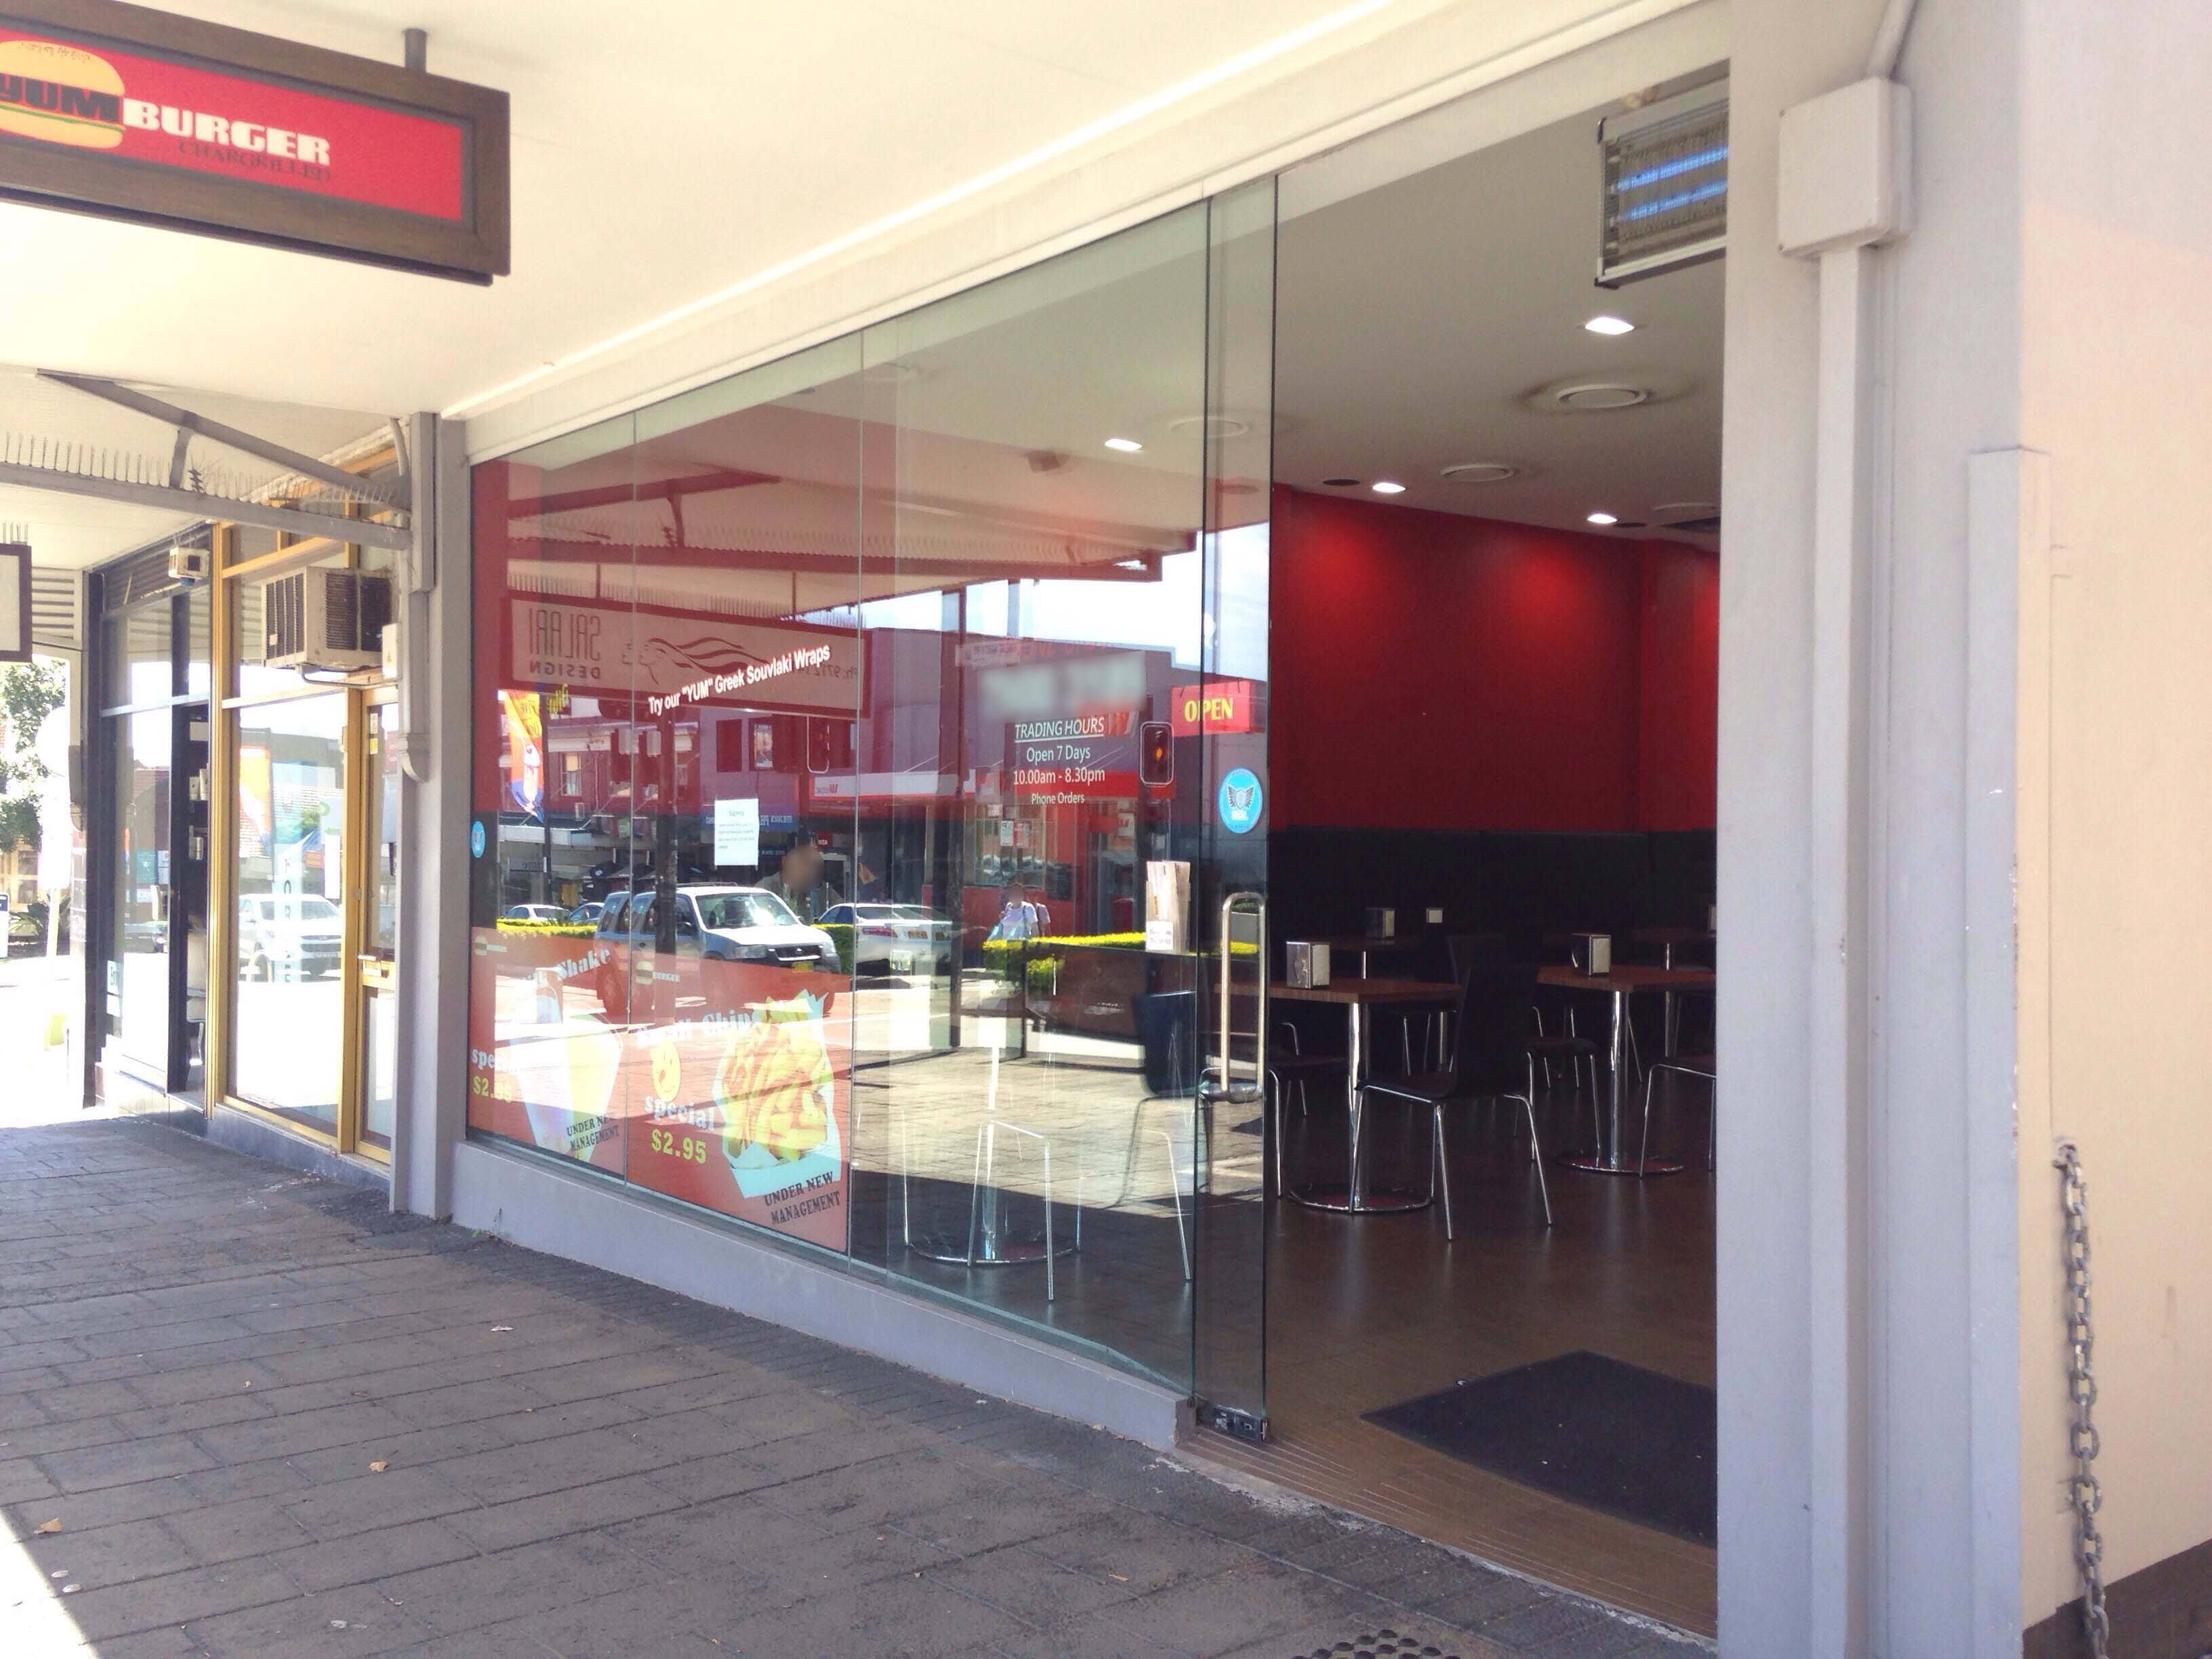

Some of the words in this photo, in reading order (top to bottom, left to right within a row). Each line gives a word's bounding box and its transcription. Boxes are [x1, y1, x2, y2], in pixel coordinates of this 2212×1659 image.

[123, 98, 331, 166] BURGER
[648, 696, 663, 716] Try
[665, 692, 680, 710] our
[682, 678, 714, 702] "YUM"
[715, 669, 745, 693] Greek
[746, 653, 792, 684] Souvlaki
[794, 645, 831, 670] Wraps
[1184, 697, 1233, 722] OPEN
[1015, 720, 1063, 739] TRADING
[1065, 716, 1105, 735] HOURS
[1026, 747, 1054, 766] Open
[1057, 745, 1063, 760] 7
[1065, 745, 1090, 764] Days
[1014, 769, 1056, 785] 10.00am
[1065, 767, 1105, 786] 8.30pm
[1031, 793, 1056, 804] Phone
[1057, 792, 1085, 804] Orders
[567, 1119, 595, 1136] UNDER
[570, 1125, 619, 1152] MANAGEMENT
[651, 1127, 707, 1164] $2.95
[764, 1183, 804, 1206] UNDER
[806, 1171, 834, 1191] NEW
[771, 1191, 841, 1225] MANAGEMENT
